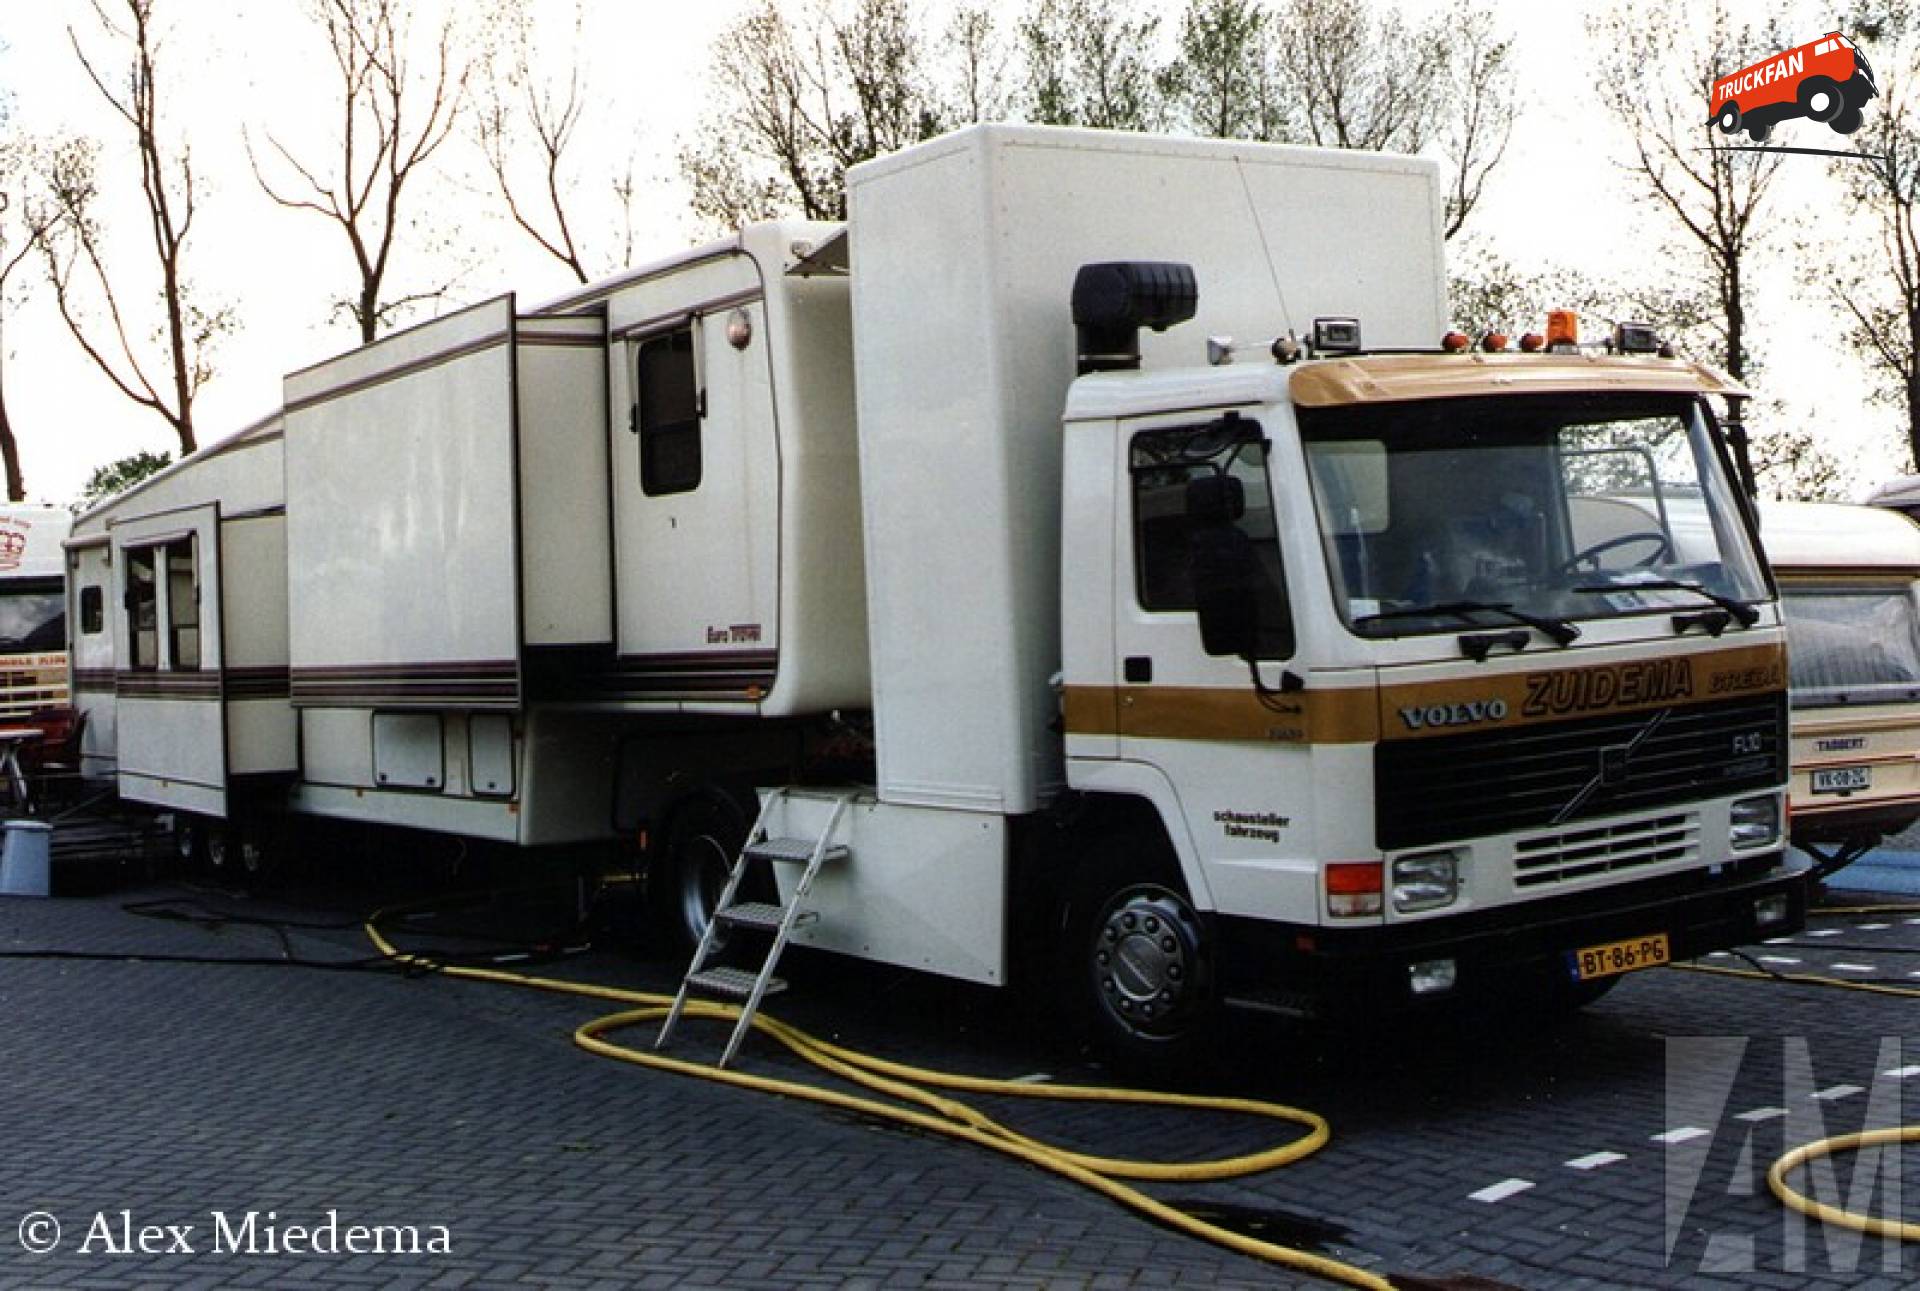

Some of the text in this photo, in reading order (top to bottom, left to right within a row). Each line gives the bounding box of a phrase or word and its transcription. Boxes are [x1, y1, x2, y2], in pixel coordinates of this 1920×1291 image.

[1521, 655, 1693, 717] ZUIDEMA
[1400, 699, 1508, 730] VOLVO
[1582, 939, 1664, 975] BT-86-PG
